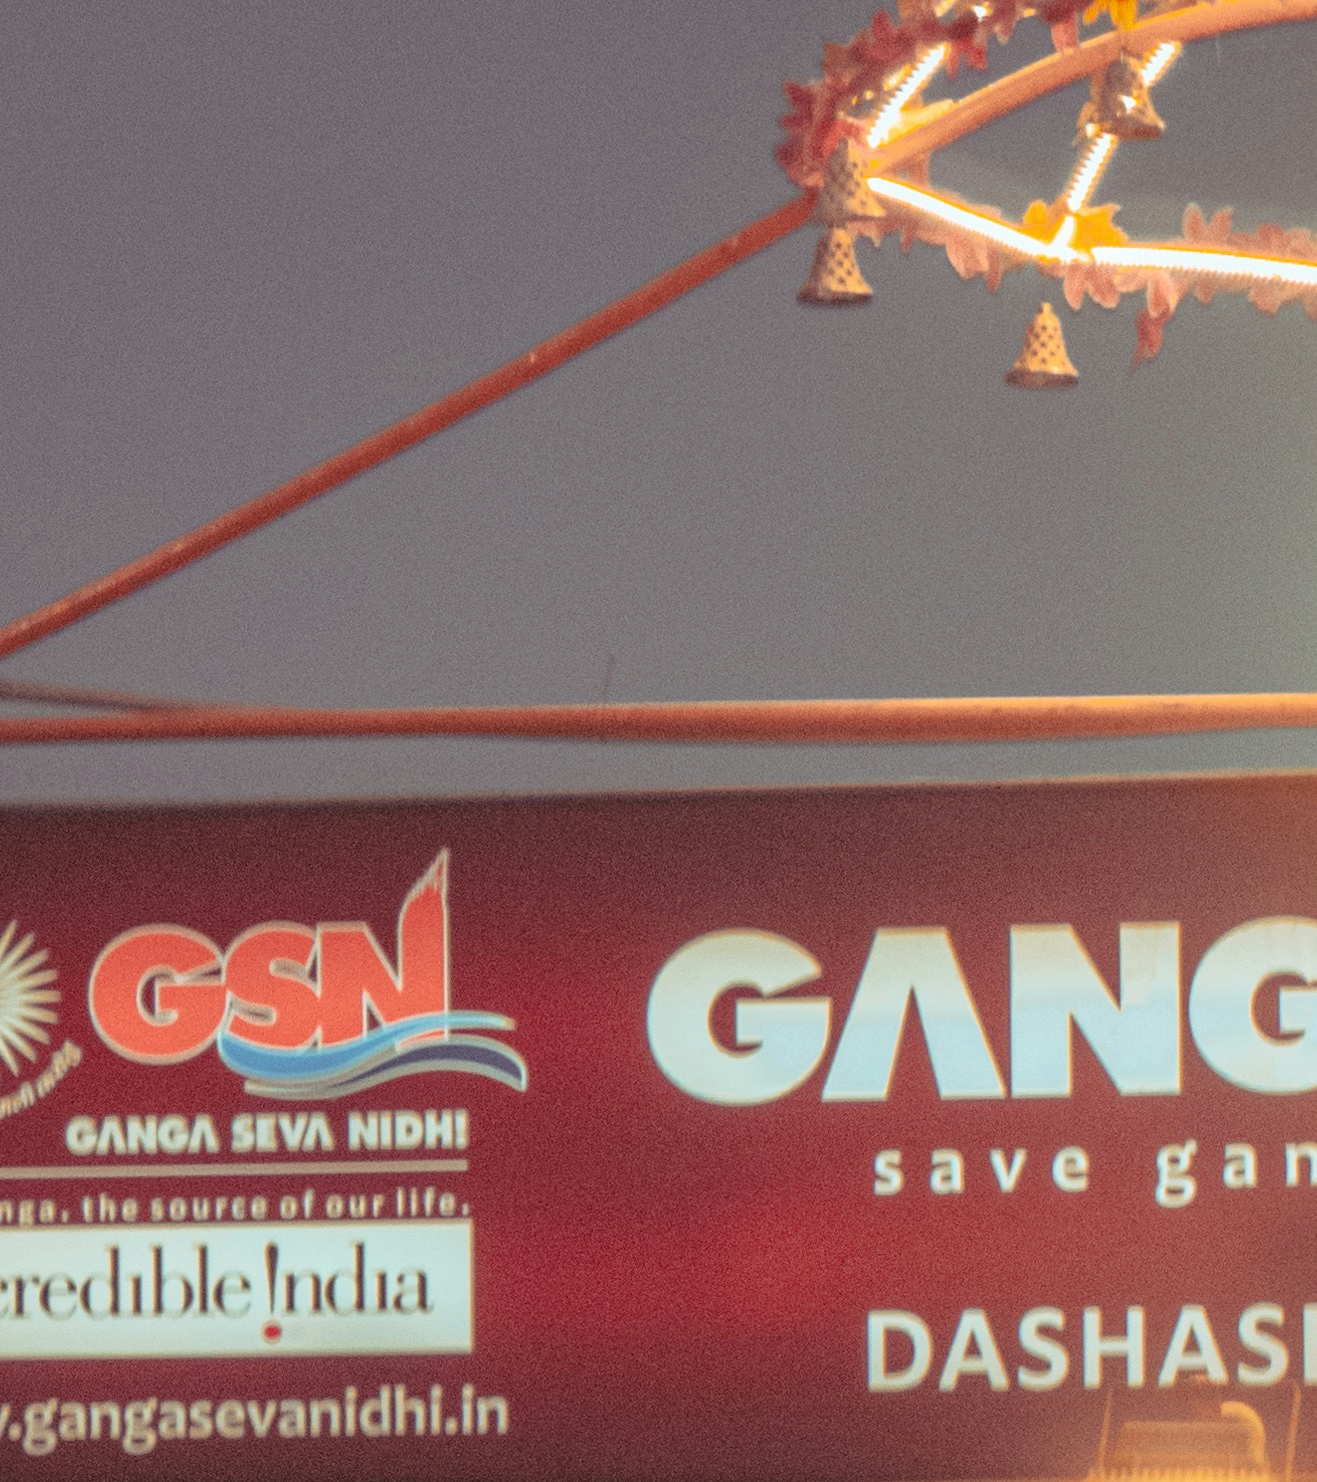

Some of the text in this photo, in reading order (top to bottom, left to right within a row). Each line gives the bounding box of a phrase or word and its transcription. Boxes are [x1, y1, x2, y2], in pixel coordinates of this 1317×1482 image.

[87, 847, 451, 1065] GSN
[64, 1113, 220, 1156] GANGA
[230, 1110, 335, 1154] SEVA
[873, 1140, 1090, 1197] save
[83, 1191, 139, 1223] the
[150, 1195, 268, 1222] source
[279, 1187, 315, 1221] of
[325, 1192, 385, 1219] our
[395, 1185, 470, 1219] life.
